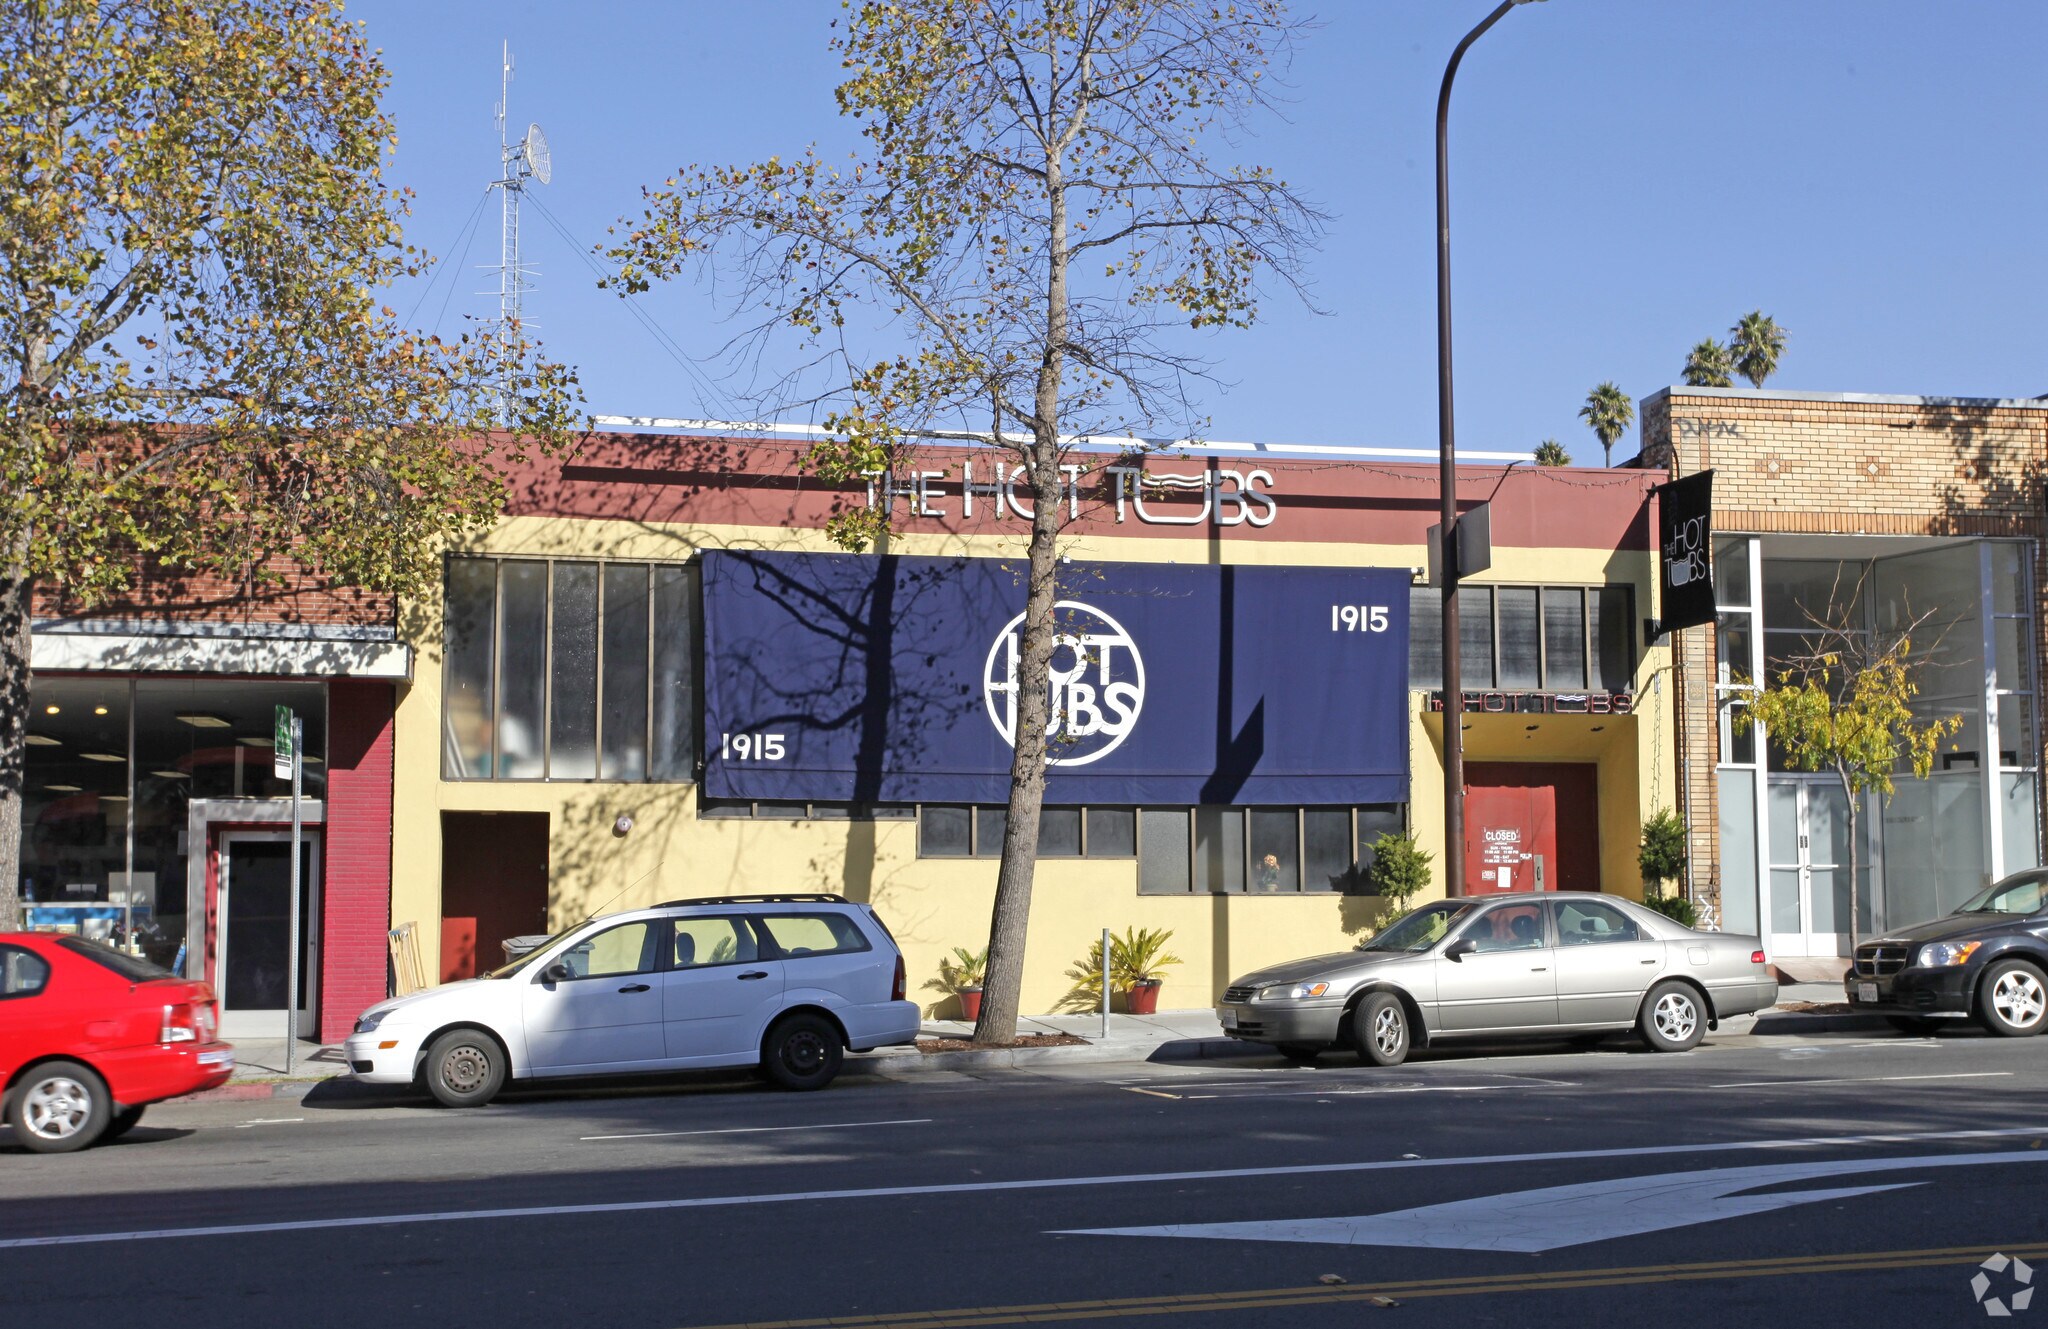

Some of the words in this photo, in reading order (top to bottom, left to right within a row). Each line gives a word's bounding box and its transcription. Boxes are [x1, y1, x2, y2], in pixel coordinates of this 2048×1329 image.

[861, 469, 946, 517] THE
[964, 461, 1088, 521] HOT
[1106, 467, 1277, 527] TUBS
[1664, 541, 1675, 556] THE
[1674, 515, 1706, 554] HOT
[1664, 548, 1706, 589] TUBS
[1332, 605, 1389, 633] 1915
[1462, 692, 1524, 712] HOT
[1535, 693, 1632, 713] TUBS
[722, 733, 786, 760] 1915
[1485, 831, 1517, 841] CLOSED
